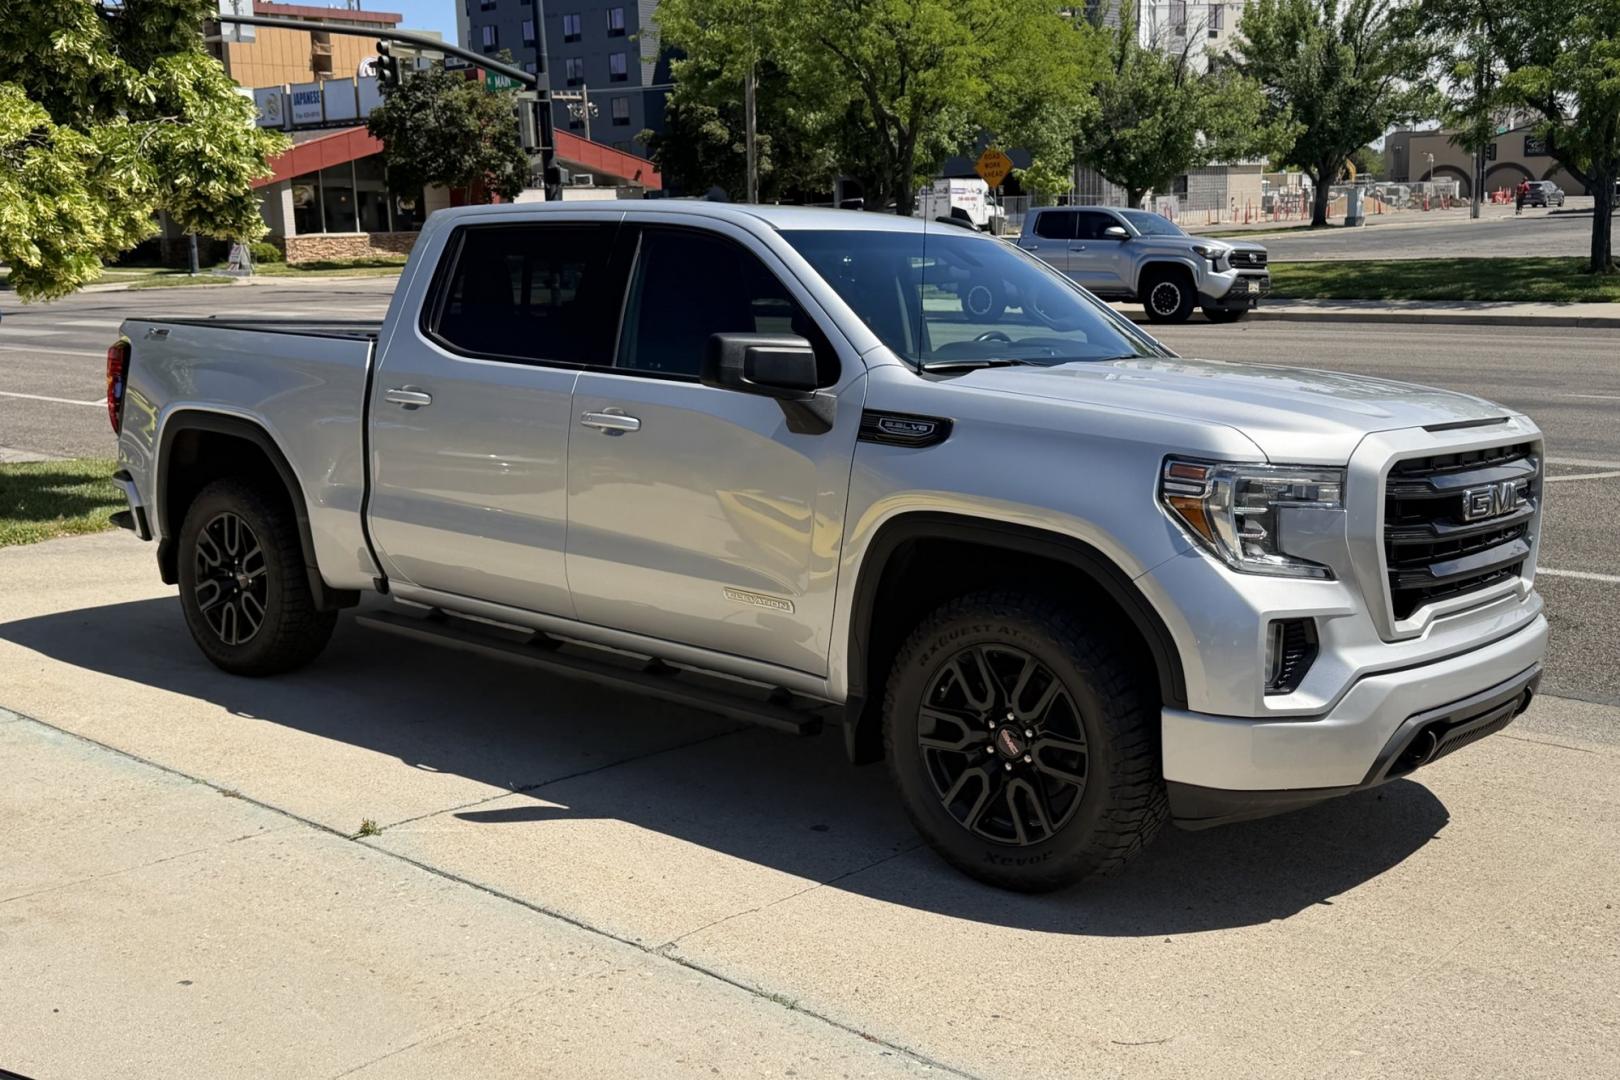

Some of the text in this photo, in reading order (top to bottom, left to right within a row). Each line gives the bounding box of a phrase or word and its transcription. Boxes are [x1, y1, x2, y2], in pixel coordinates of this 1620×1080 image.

[494, 74, 511, 88] MAIN
[293, 91, 320, 105] JAPANESE
[1462, 478, 1528, 521] GMC
